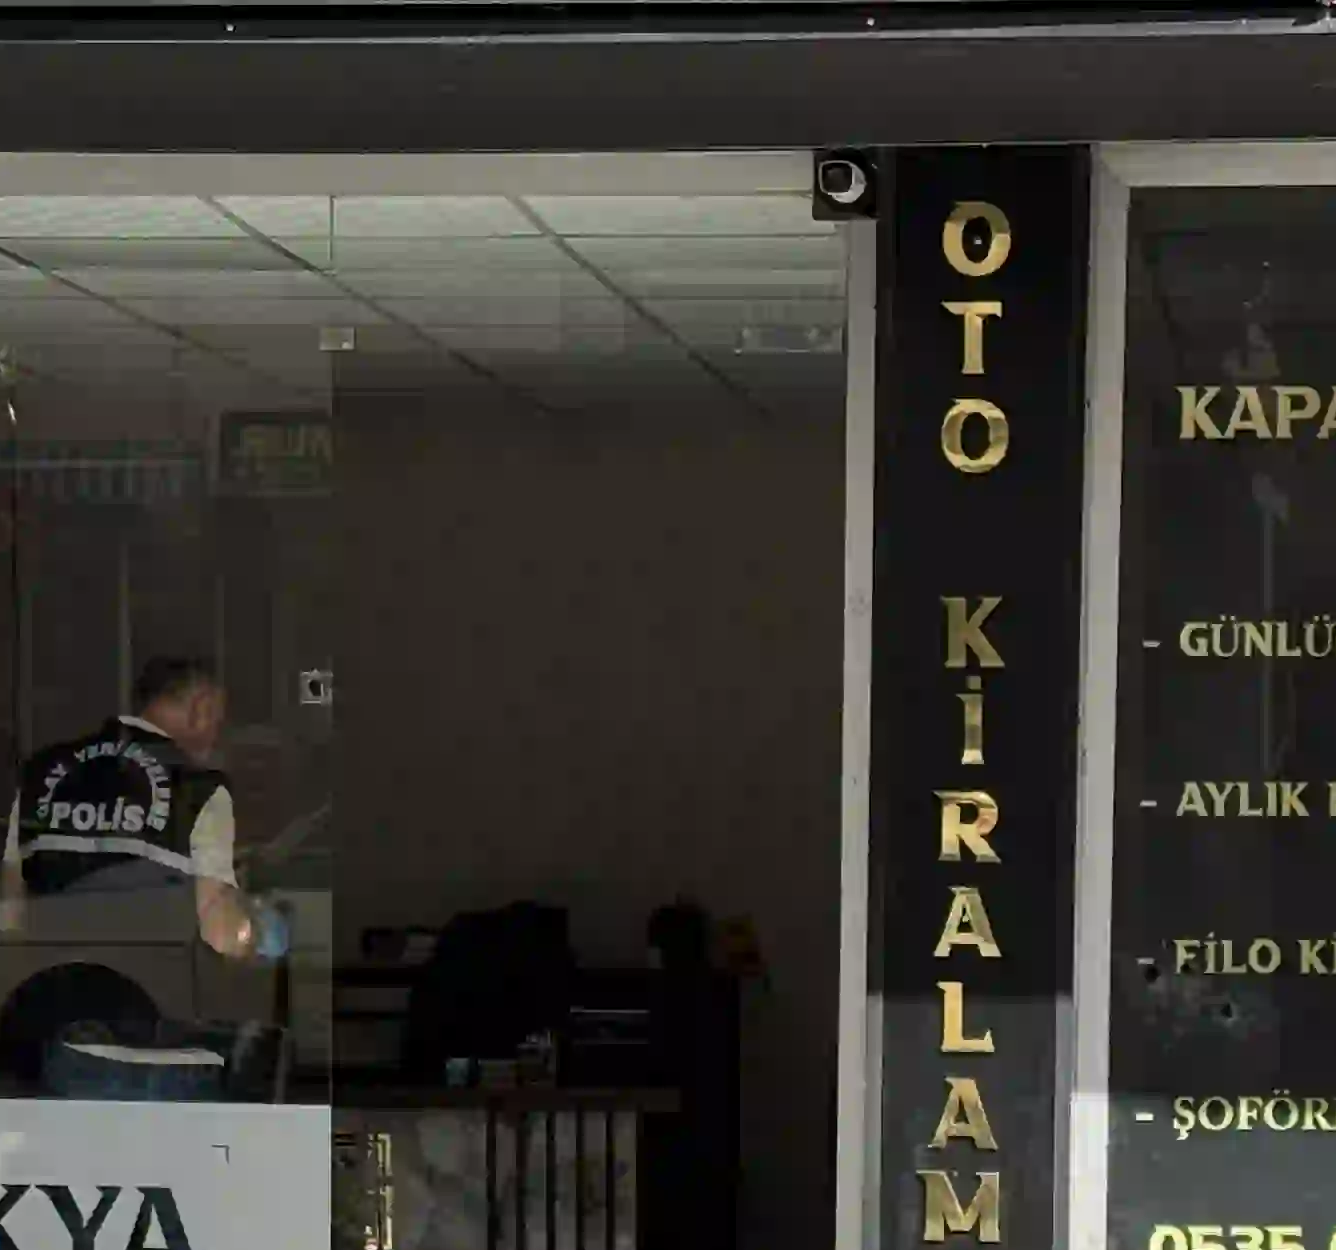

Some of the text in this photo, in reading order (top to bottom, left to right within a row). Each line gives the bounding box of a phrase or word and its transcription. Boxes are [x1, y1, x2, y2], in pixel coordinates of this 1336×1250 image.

[940, 201, 1012, 473] OTO
[1176, 780, 1309, 818] AYLIK
[1173, 932, 1282, 976] FİLO
